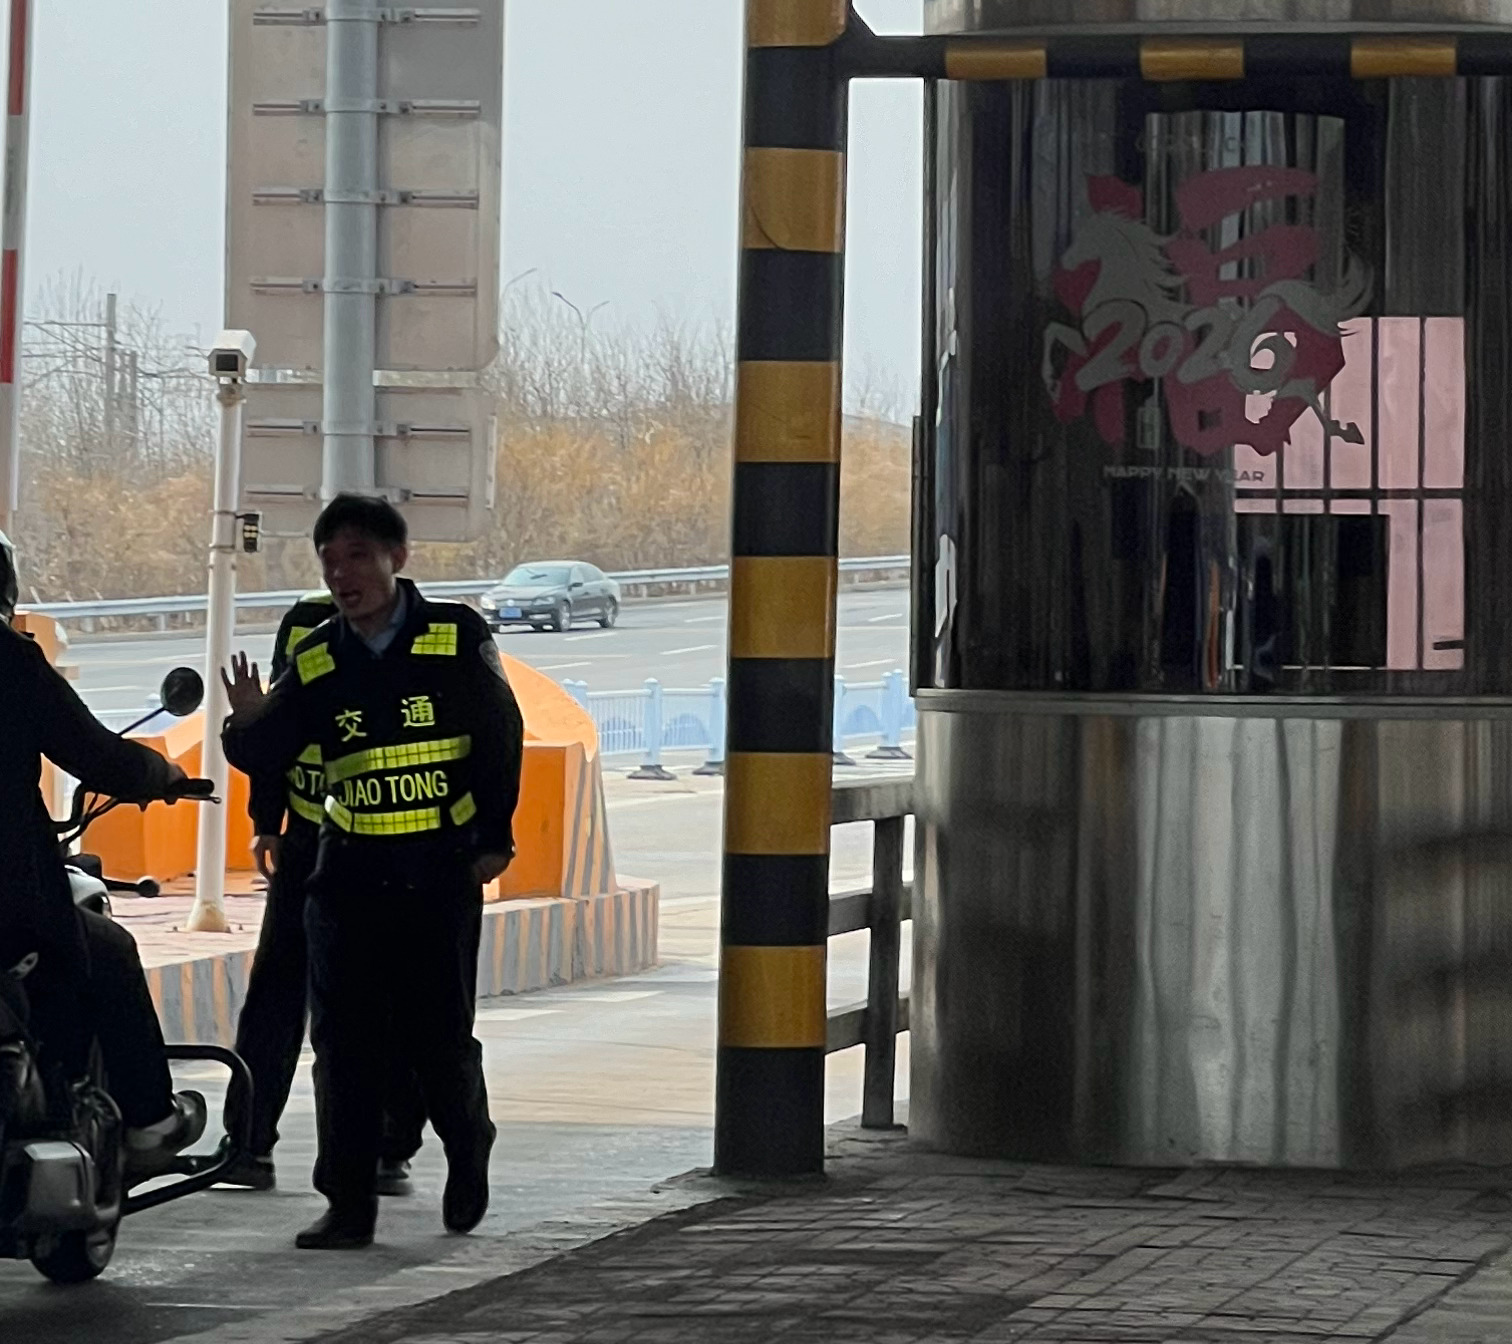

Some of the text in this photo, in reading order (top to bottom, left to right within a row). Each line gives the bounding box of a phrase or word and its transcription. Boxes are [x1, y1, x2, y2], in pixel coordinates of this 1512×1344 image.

[1075, 297, 1298, 394] 2026
[1102, 465, 1162, 480] HAPPY
[1167, 466, 1211, 481] NEW
[335, 695, 436, 742] 交通
[339, 770, 449, 806] JIAO TONG
